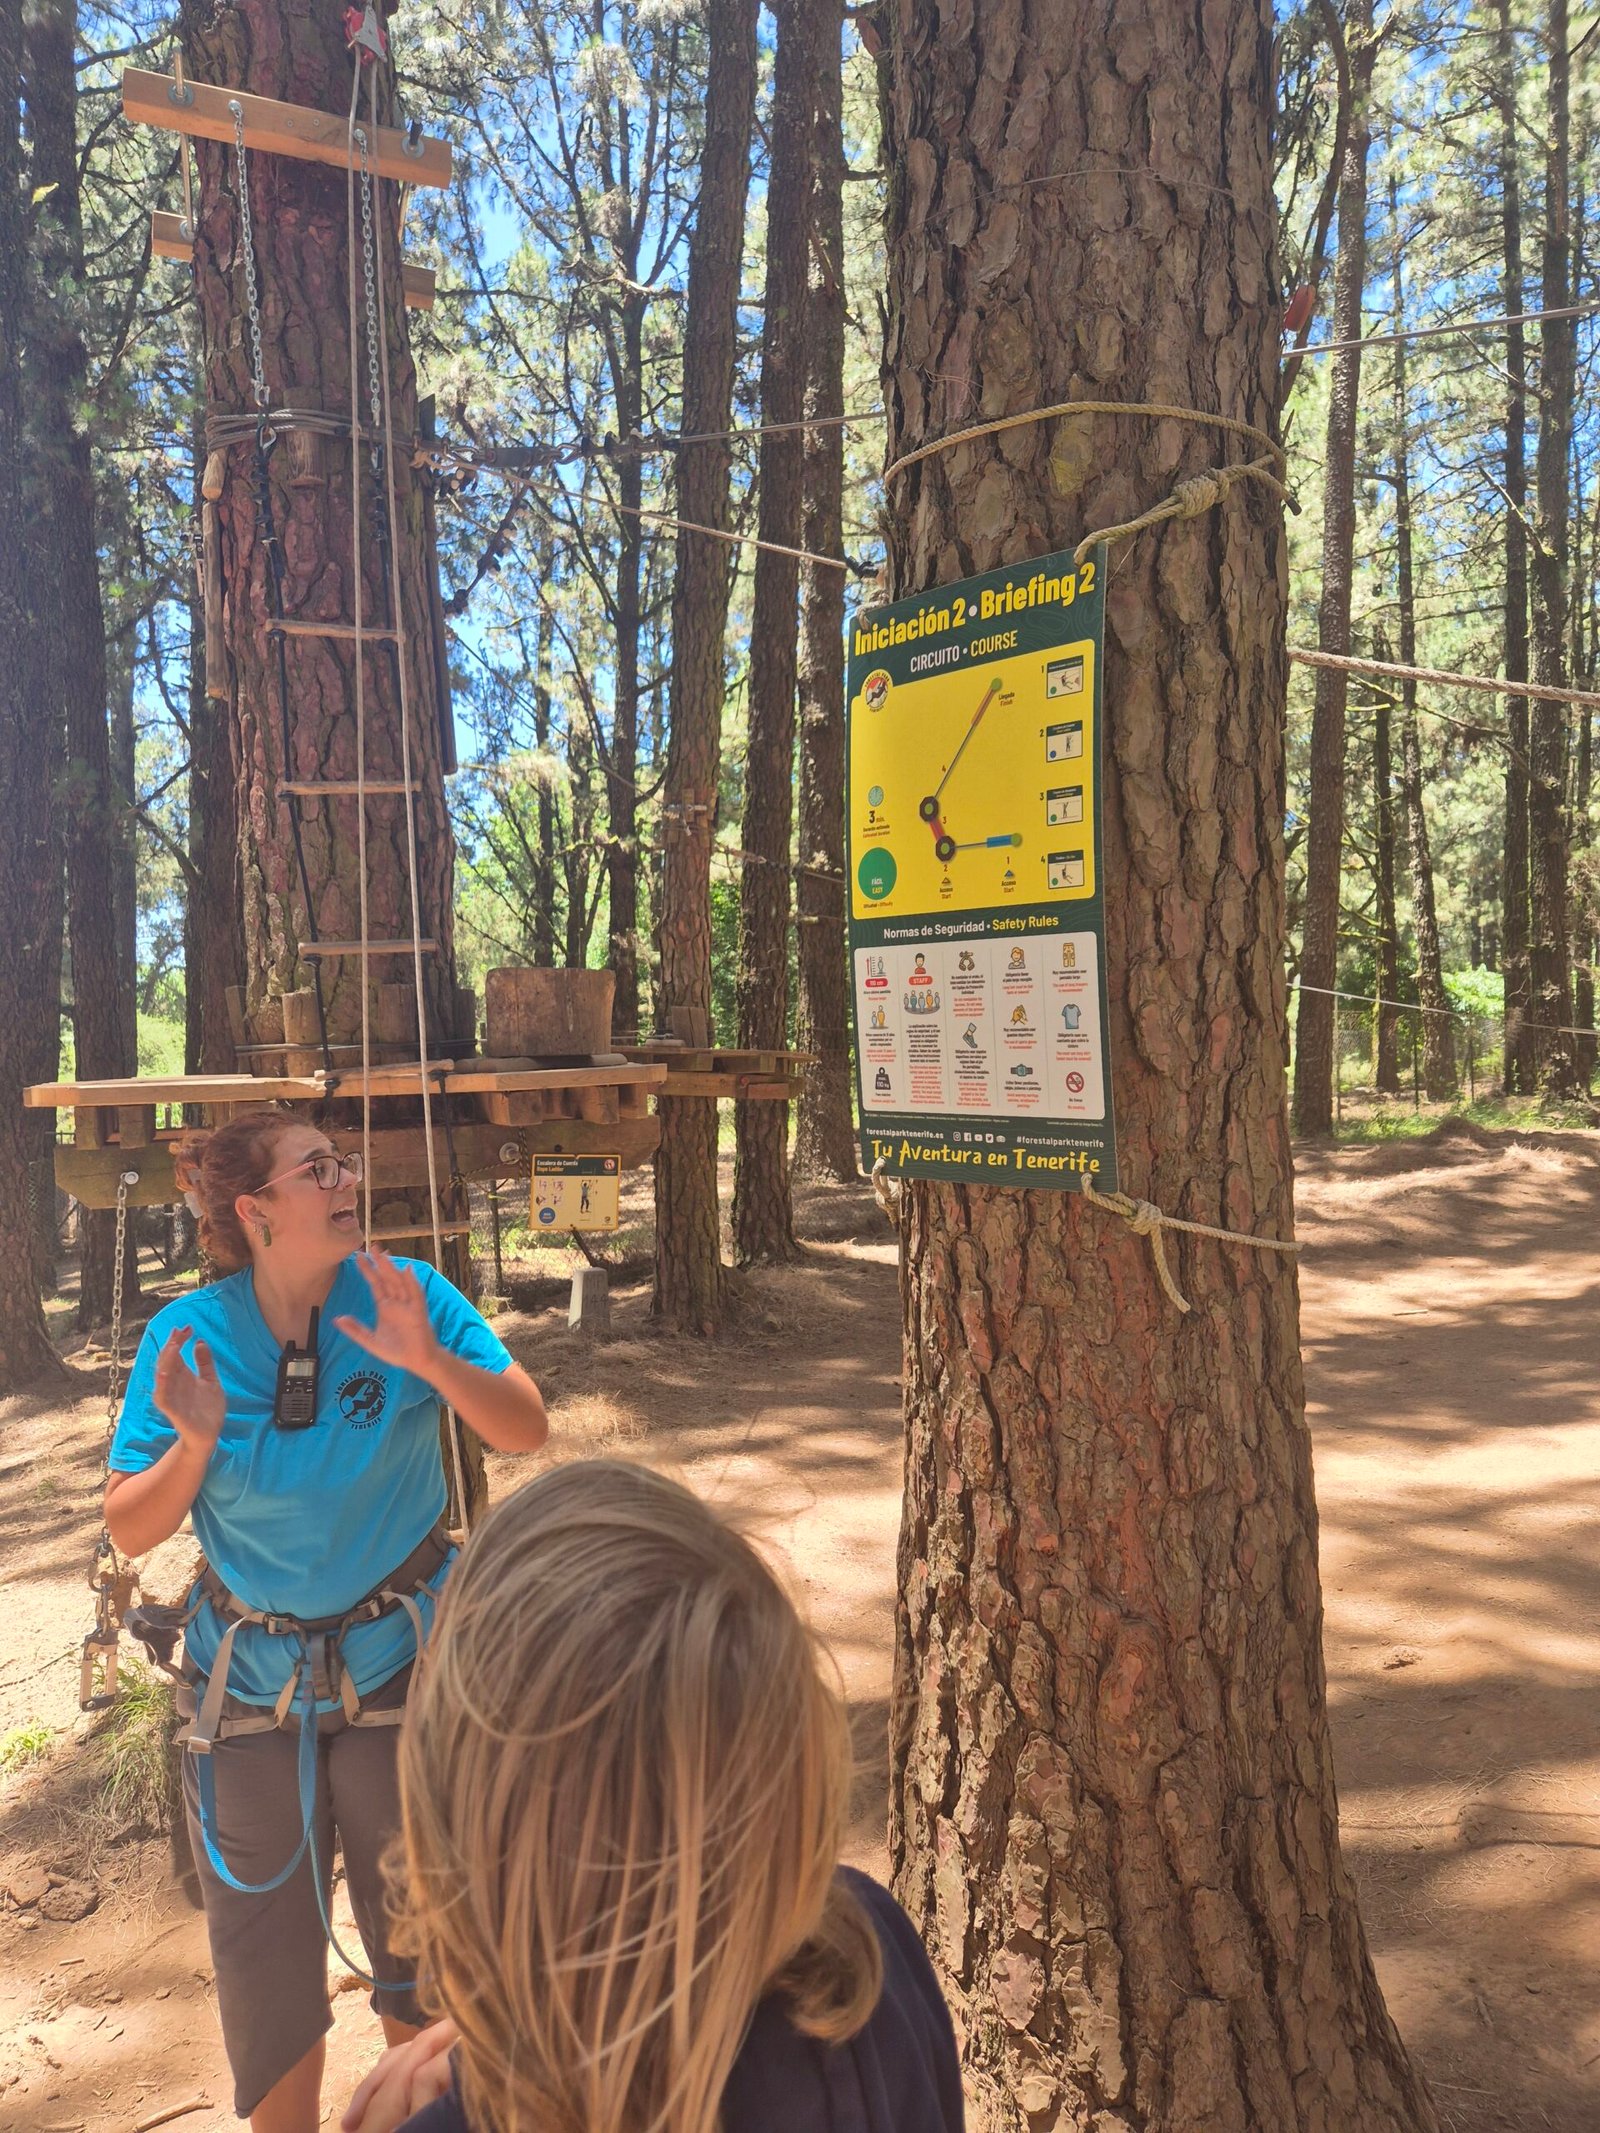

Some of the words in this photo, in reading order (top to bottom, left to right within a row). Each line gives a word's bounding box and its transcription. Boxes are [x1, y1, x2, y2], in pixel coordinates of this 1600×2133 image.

[855, 606, 951, 656] Iniciación
[952, 598, 967, 628] 2
[980, 572, 1076, 620] Briefing
[1078, 562, 1096, 595] 2
[910, 645, 960, 674] CIRCUITO
[970, 630, 1019, 658] COURSE
[1039, 729, 1045, 737] 2
[1039, 792, 1045, 801] 3
[869, 810, 876, 824] 3
[883, 925, 919, 939] Normas
[921, 925, 933, 936] de
[935, 921, 985, 937] Seguridad
[992, 917, 1026, 931] Safety
[1029, 915, 1059, 928] Rules
[866, 1128, 944, 1139] forestalparktenerife.es
[1017, 1135, 1104, 1148] #forestalparktenerife
[871, 1140, 893, 1159] Tu
[899, 1139, 981, 1167] Aventura
[987, 1150, 1008, 1166] en
[1012, 1148, 1100, 1173] Tenerife
